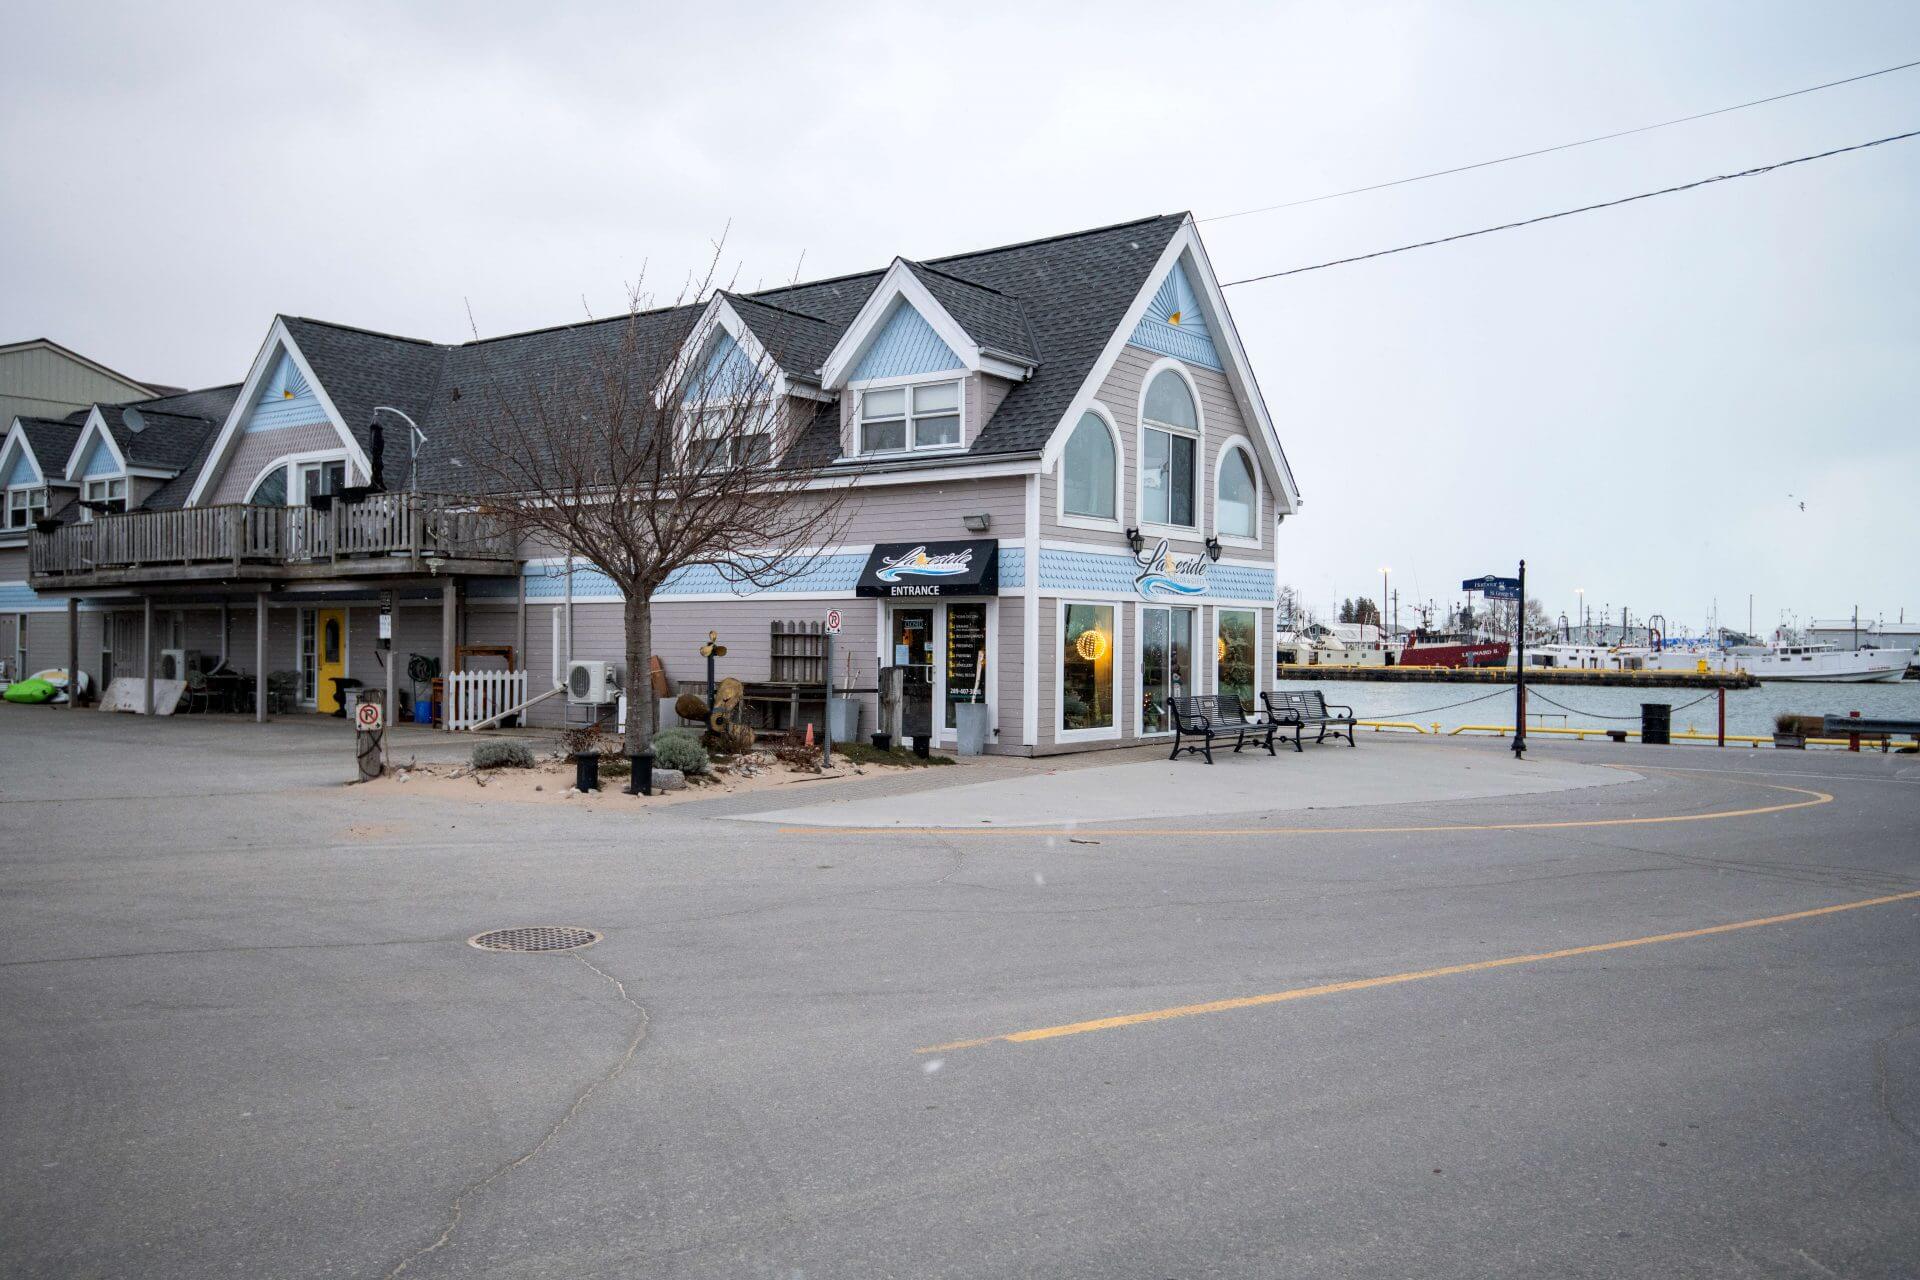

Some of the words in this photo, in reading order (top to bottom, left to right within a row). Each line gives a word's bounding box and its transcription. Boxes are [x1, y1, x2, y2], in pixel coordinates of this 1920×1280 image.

[877, 546, 973, 574] Laeside
[1136, 540, 1207, 583] Laeside
[891, 585, 940, 596] ENTRANCE
[1461, 649, 1492, 658] LENARD
